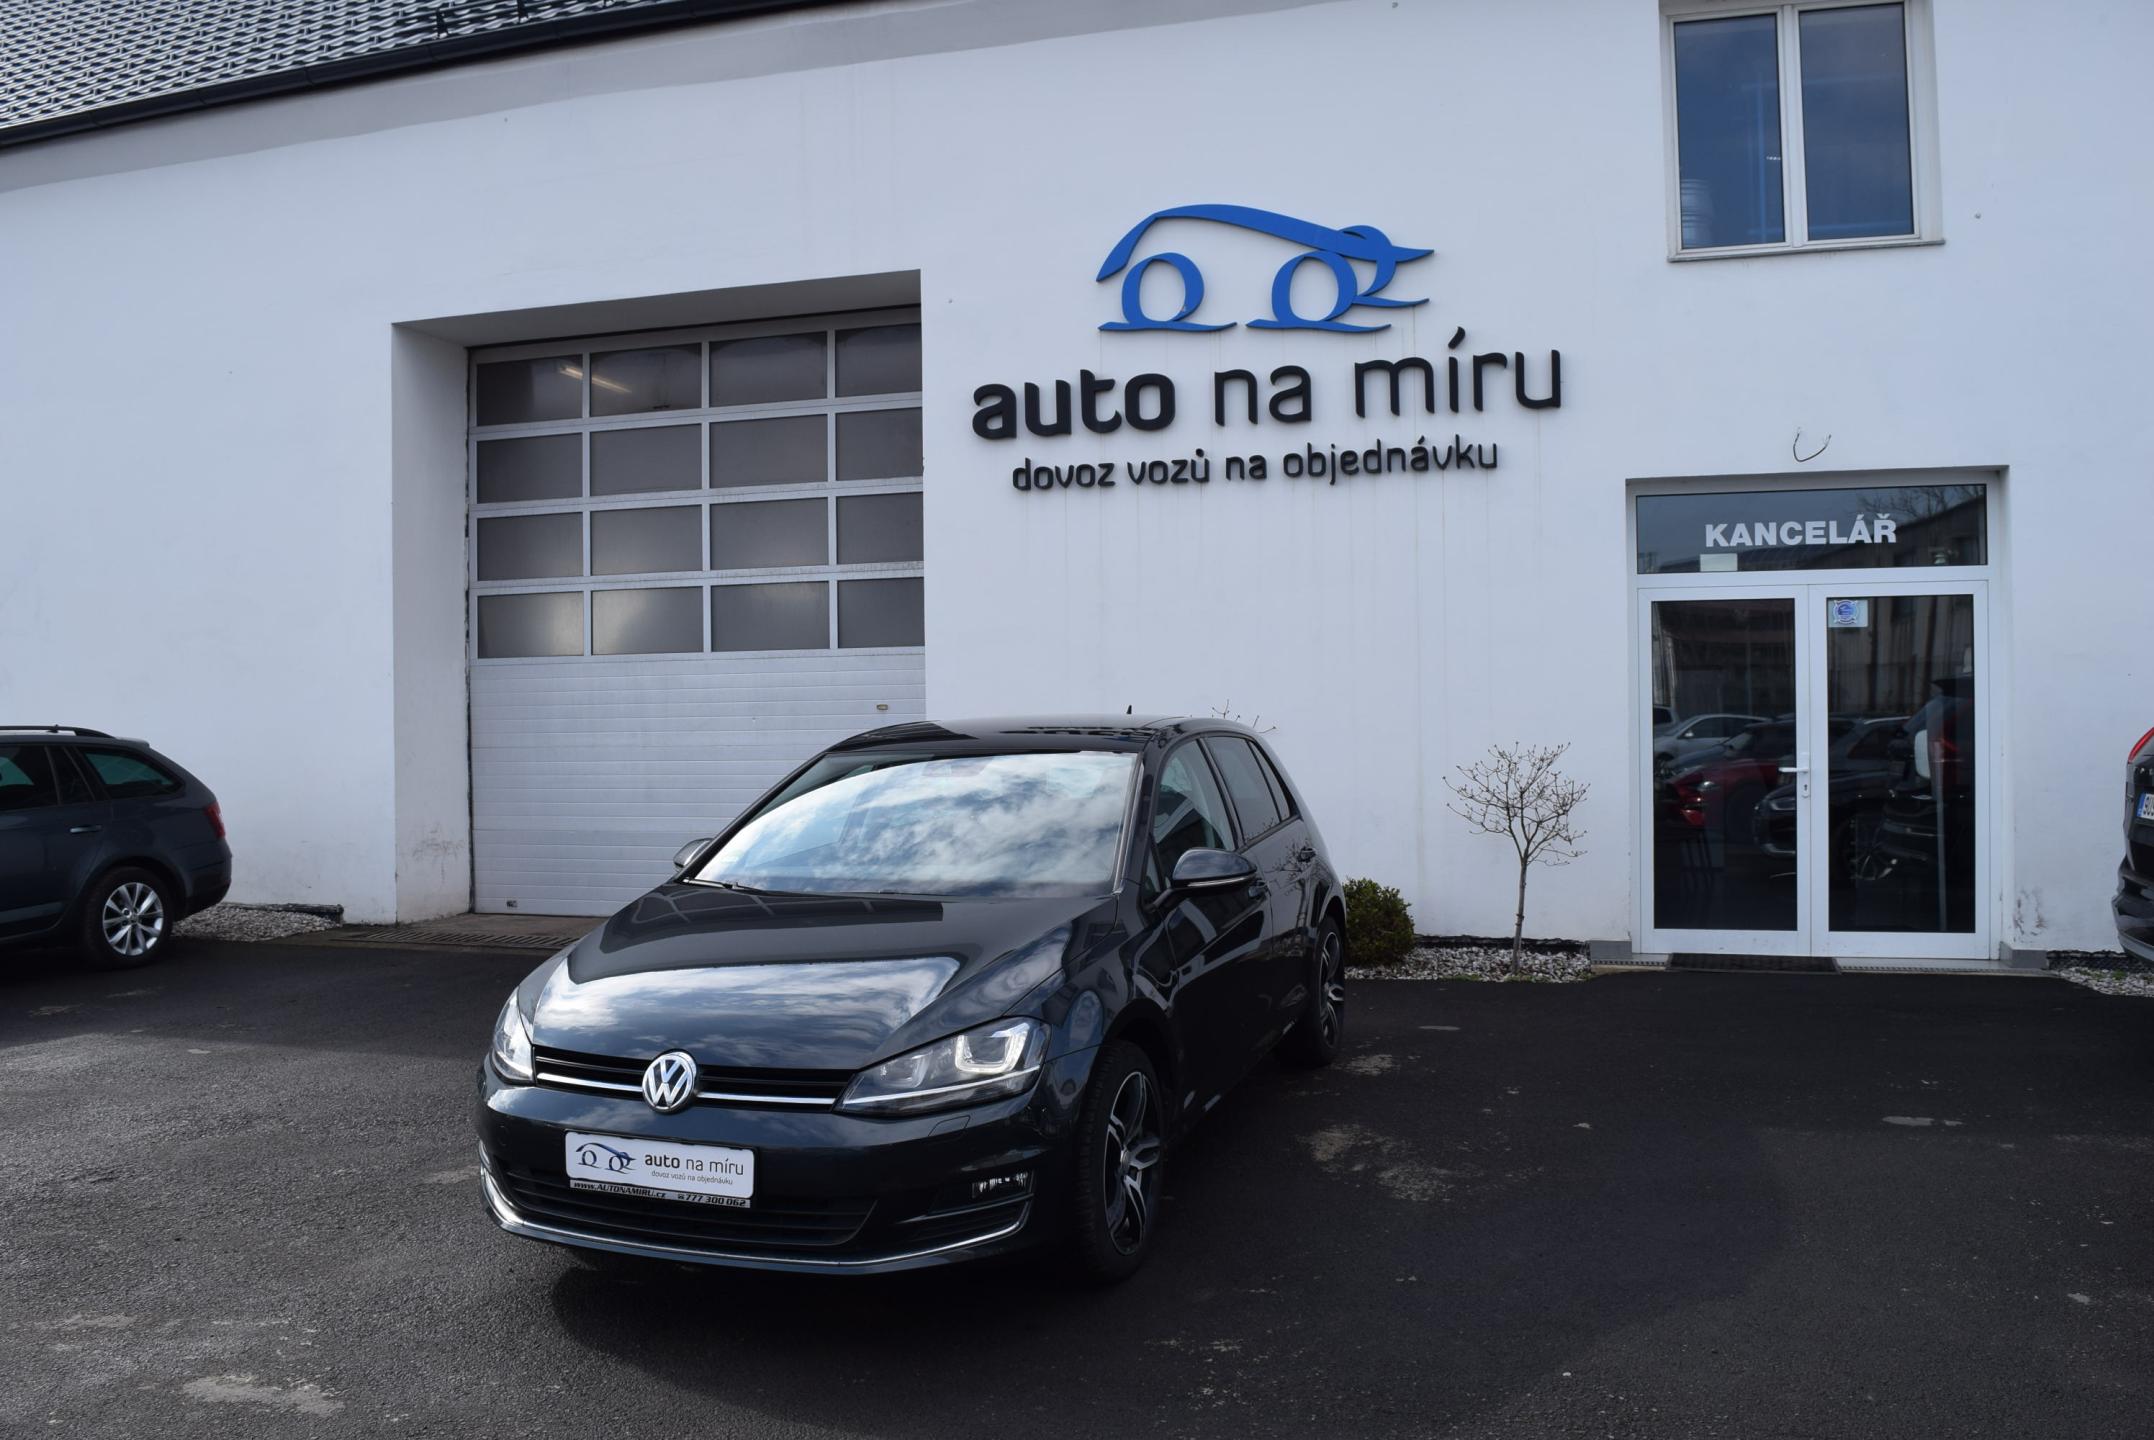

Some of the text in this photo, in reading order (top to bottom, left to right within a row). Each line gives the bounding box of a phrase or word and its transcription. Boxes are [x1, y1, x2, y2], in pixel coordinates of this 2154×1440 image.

[972, 326, 1562, 442] auto na míru
[1012, 434, 1498, 492] dovoz vozů na objednávku
[1705, 513, 1897, 548] KANCELÁŘ
[644, 1154, 744, 1176] auto na míru
[651, 1170, 670, 1178] dovoz
[687, 1174, 696, 1182] na
[696, 1174, 734, 1186] objednávku
[726, 1198, 747, 1208] 062
